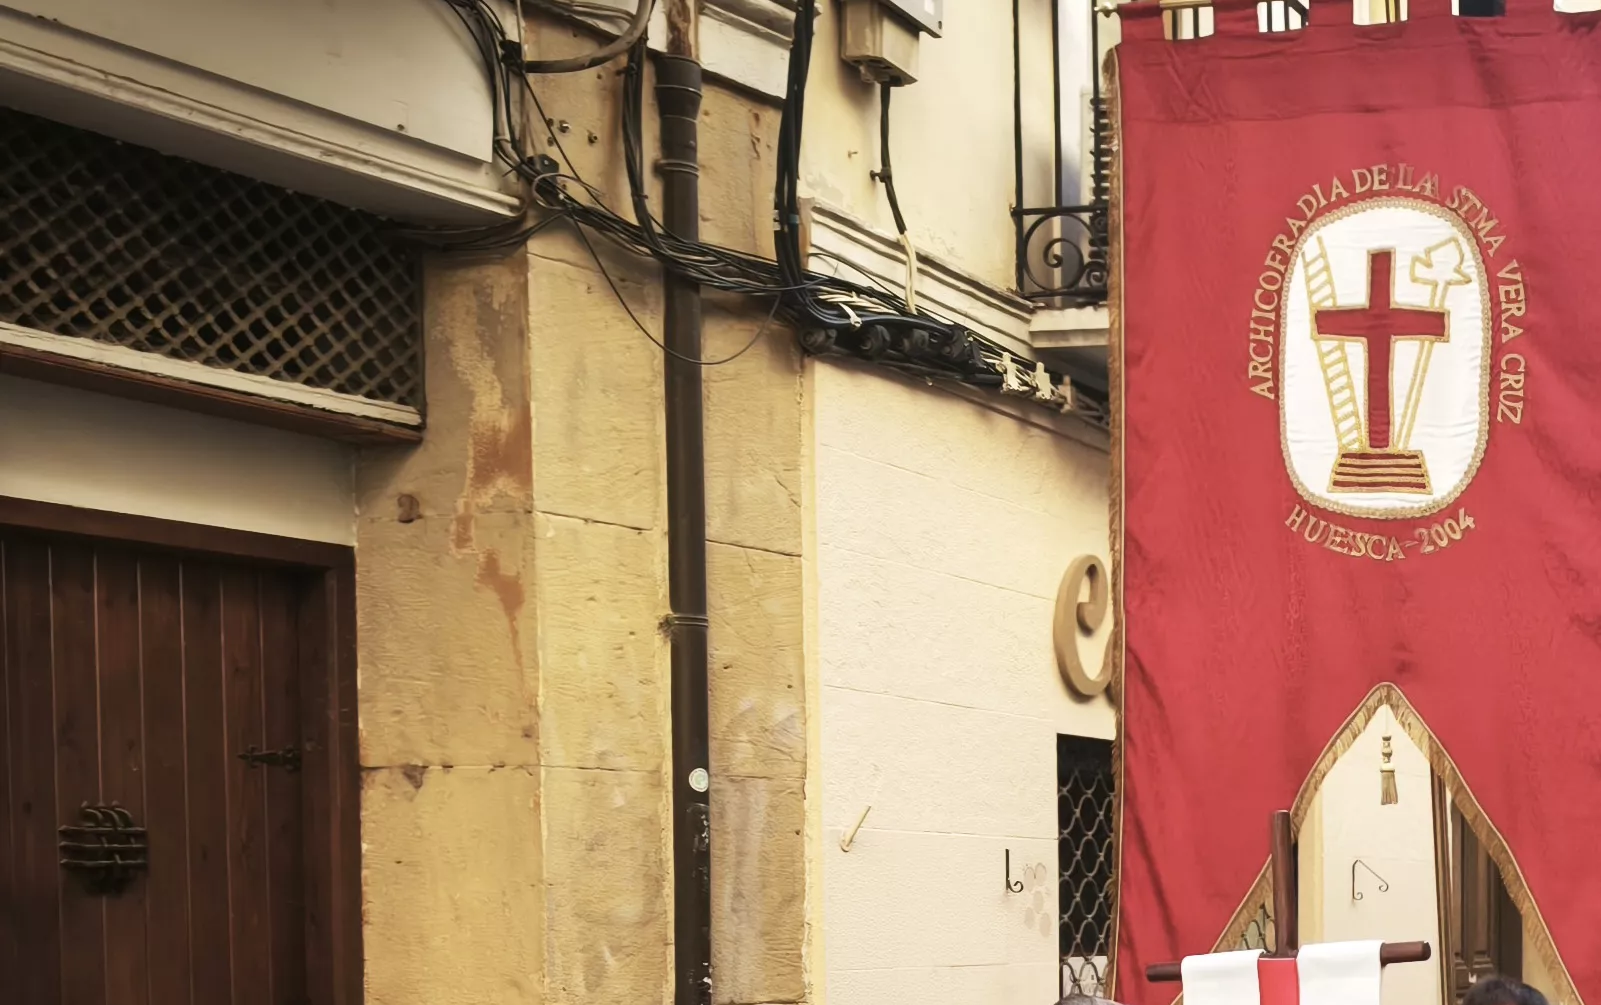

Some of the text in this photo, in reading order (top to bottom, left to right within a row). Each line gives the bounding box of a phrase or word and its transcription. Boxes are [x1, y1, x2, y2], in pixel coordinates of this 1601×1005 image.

[1248, 163, 1528, 425] ARCHICOFRADIA DE LA STMA VERA CRUZ
